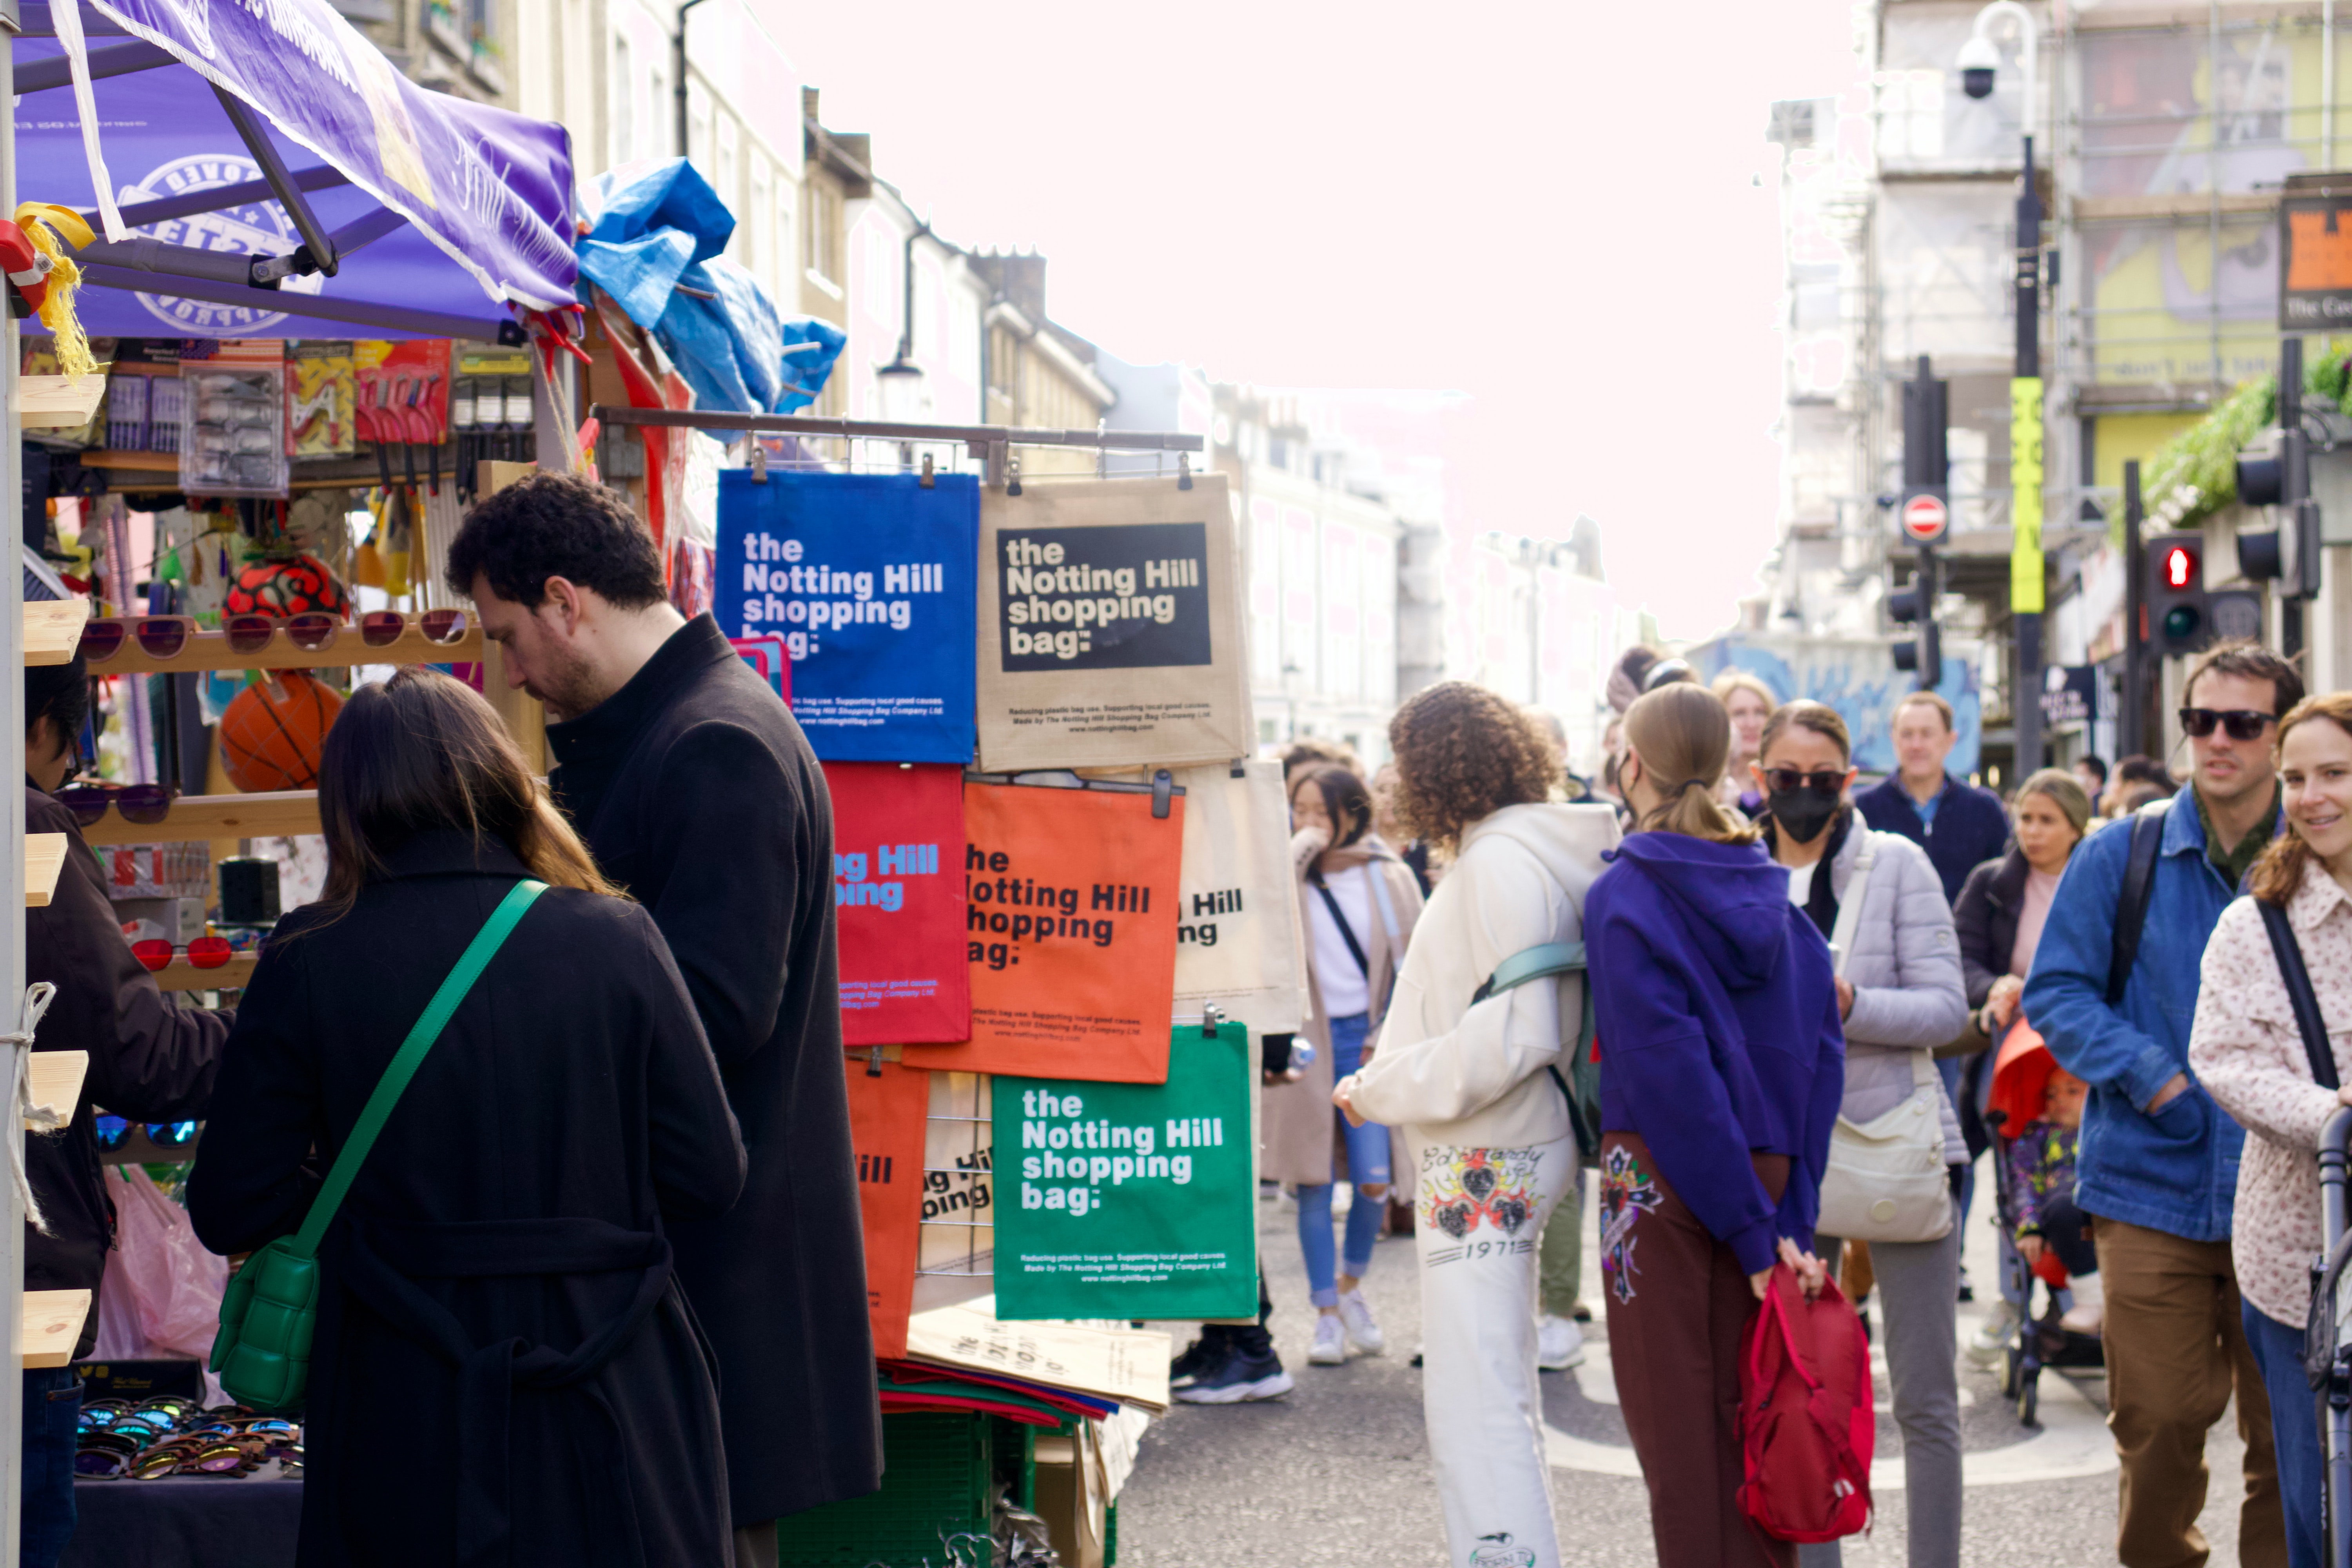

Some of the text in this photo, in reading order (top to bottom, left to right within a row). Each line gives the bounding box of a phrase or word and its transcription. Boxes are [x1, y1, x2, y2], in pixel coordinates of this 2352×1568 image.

[743, 532, 803, 562] the
[1006, 537, 1065, 567] the
[743, 563, 942, 601] Notting Hill
[1007, 558, 1199, 597] Notting Hill
[743, 593, 911, 631] shopping
[1008, 594, 1175, 628] shopping
[835, 697, 876, 706] Supporting
[896, 697, 915, 706] good
[838, 707, 874, 717] Shopping
[875, 707, 890, 716] Bag
[891, 707, 927, 717] Company
[1045, 706, 1069, 715] plastic
[1103, 704, 1143, 713] Supporting
[1061, 715, 1089, 724] Notting
[1106, 713, 1142, 722] Shopping
[1144, 713, 1159, 721] Bag
[1161, 712, 1196, 720] Company
[879, 844, 938, 875] Hill
[966, 843, 1009, 873] he
[1092, 884, 1149, 913] Hill
[1193, 888, 1243, 916] Hill
[968, 904, 1113, 947] hopping
[867, 991, 882, 999] Bag
[1032, 1011, 1072, 1022] Supporting
[1034, 1021, 1070, 1032] Shopping
[1073, 1024, 1087, 1033] Bag
[1089, 1026, 1124, 1035] Company
[1022, 1089, 1083, 1118] the
[1022, 1118, 1223, 1156] Notting Hill
[855, 1154, 892, 1184] ill
[1022, 1150, 1192, 1186] shopping
[1020, 1254, 1056, 1263] Reducing
[1117, 1253, 1158, 1262] Supporting
[1179, 1253, 1198, 1261] good
[1466, 1241, 1516, 1259] 1971
[1046, 1264, 1056, 1272] by
[1074, 1264, 1103, 1273] Notting
[1120, 1263, 1157, 1272] Shopping
[1158, 1263, 1174, 1272] Bag
[1176, 1263, 1210, 1271] Company
